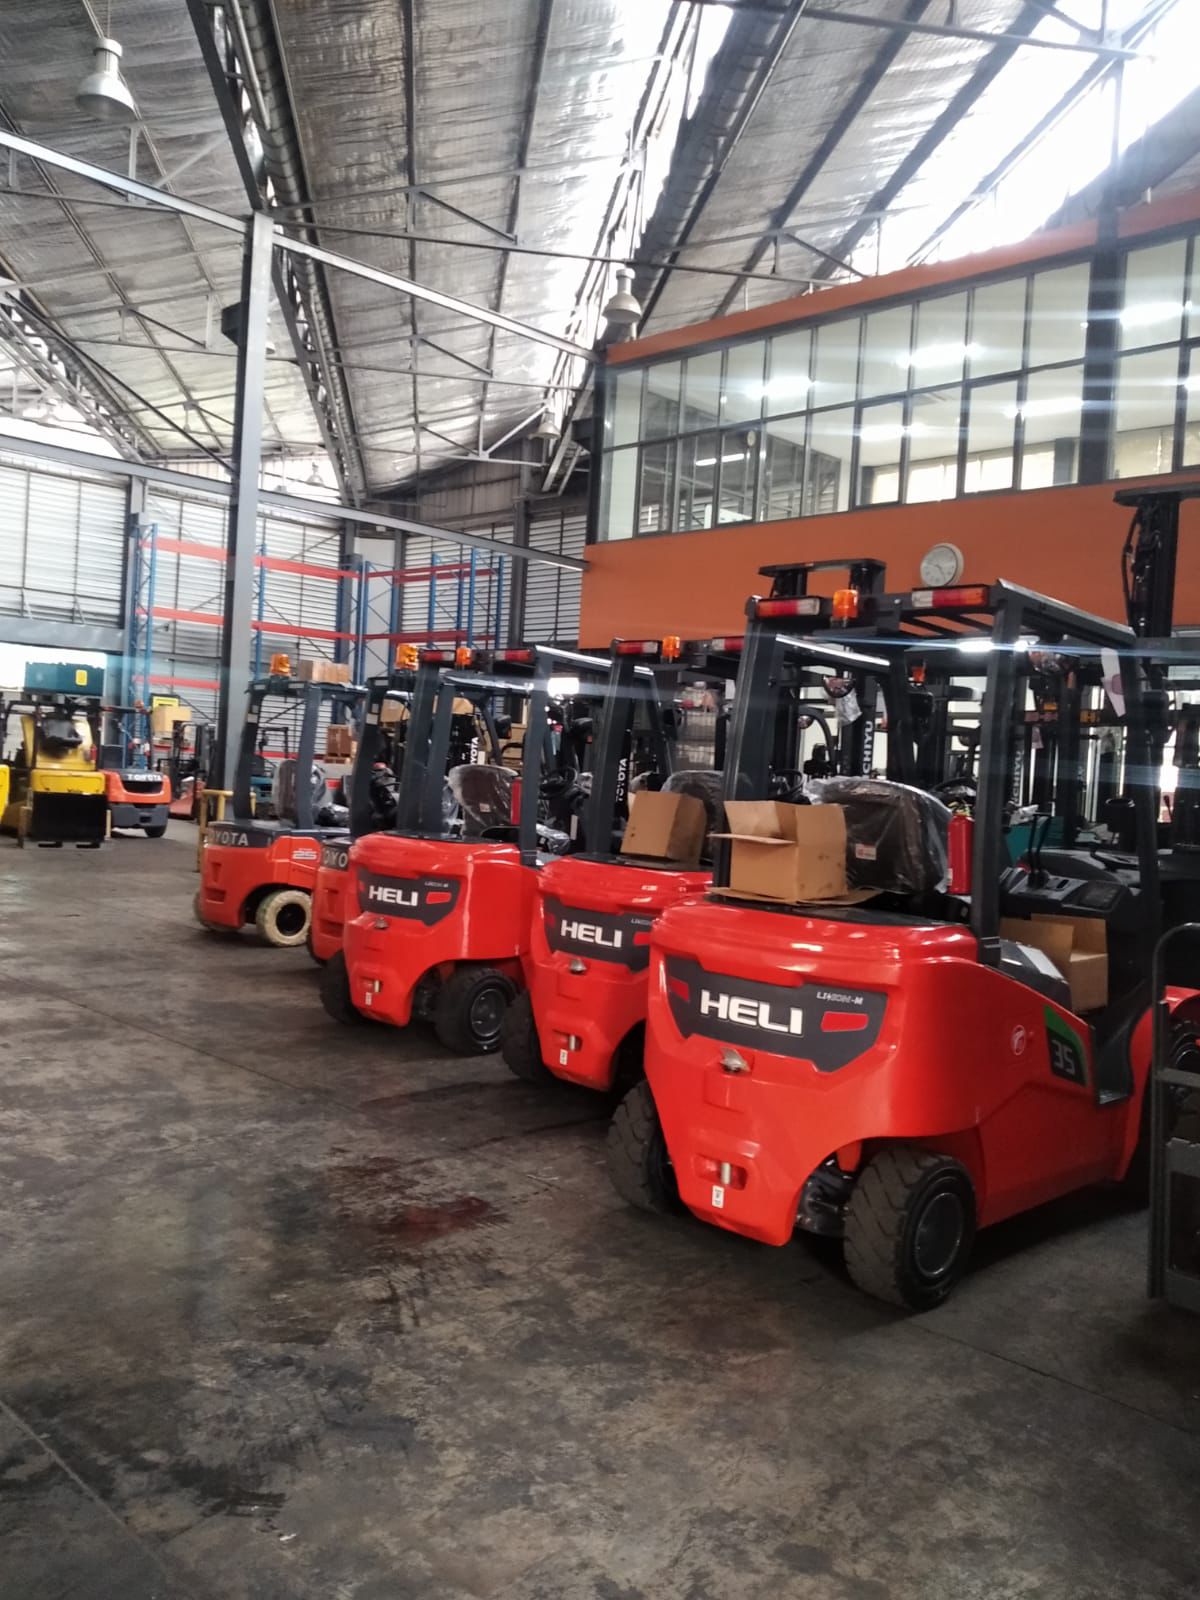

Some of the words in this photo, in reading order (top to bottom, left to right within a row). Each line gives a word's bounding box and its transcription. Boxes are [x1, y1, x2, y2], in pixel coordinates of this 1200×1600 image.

[368, 884, 419, 908] HELI
[560, 919, 623, 948] HELI
[700, 989, 804, 1036] HELI
[1051, 1039, 1076, 1076] 35
